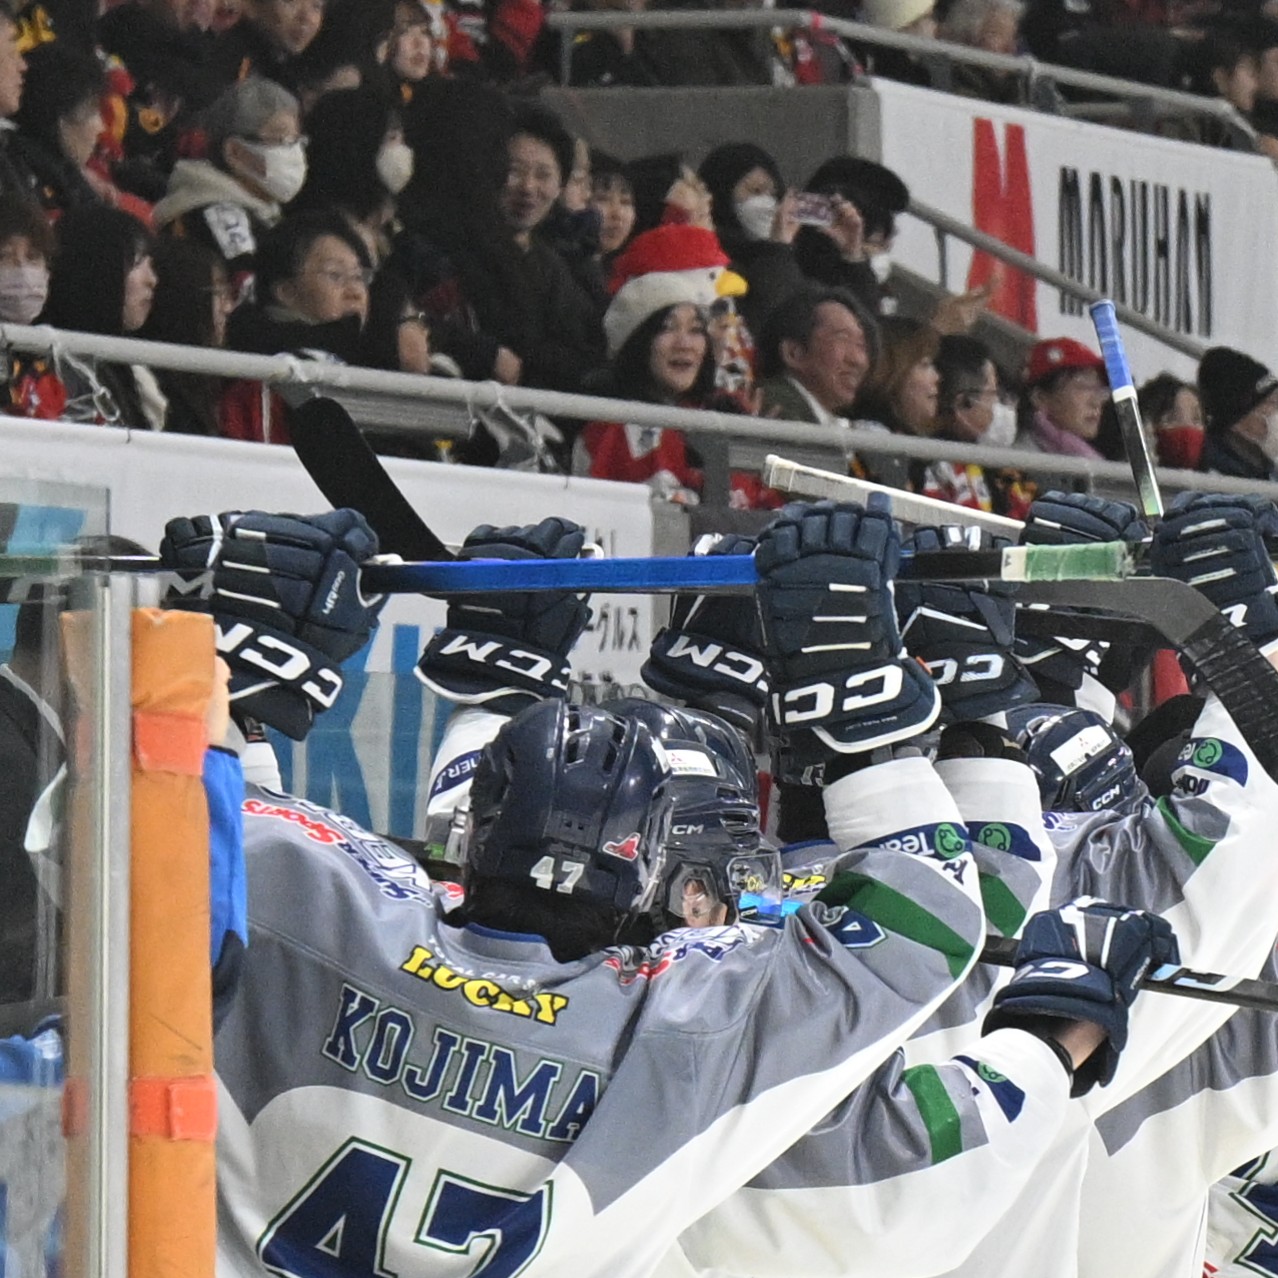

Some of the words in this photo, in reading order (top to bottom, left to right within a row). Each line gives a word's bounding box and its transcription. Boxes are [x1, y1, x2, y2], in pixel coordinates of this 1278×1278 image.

[1059, 166, 1212, 337] MARUHAN
[772, 663, 904, 726] CC
[530, 855, 585, 893] 47
[400, 944, 570, 1027] LUCKY
[321, 982, 606, 1142] KOJIMA
